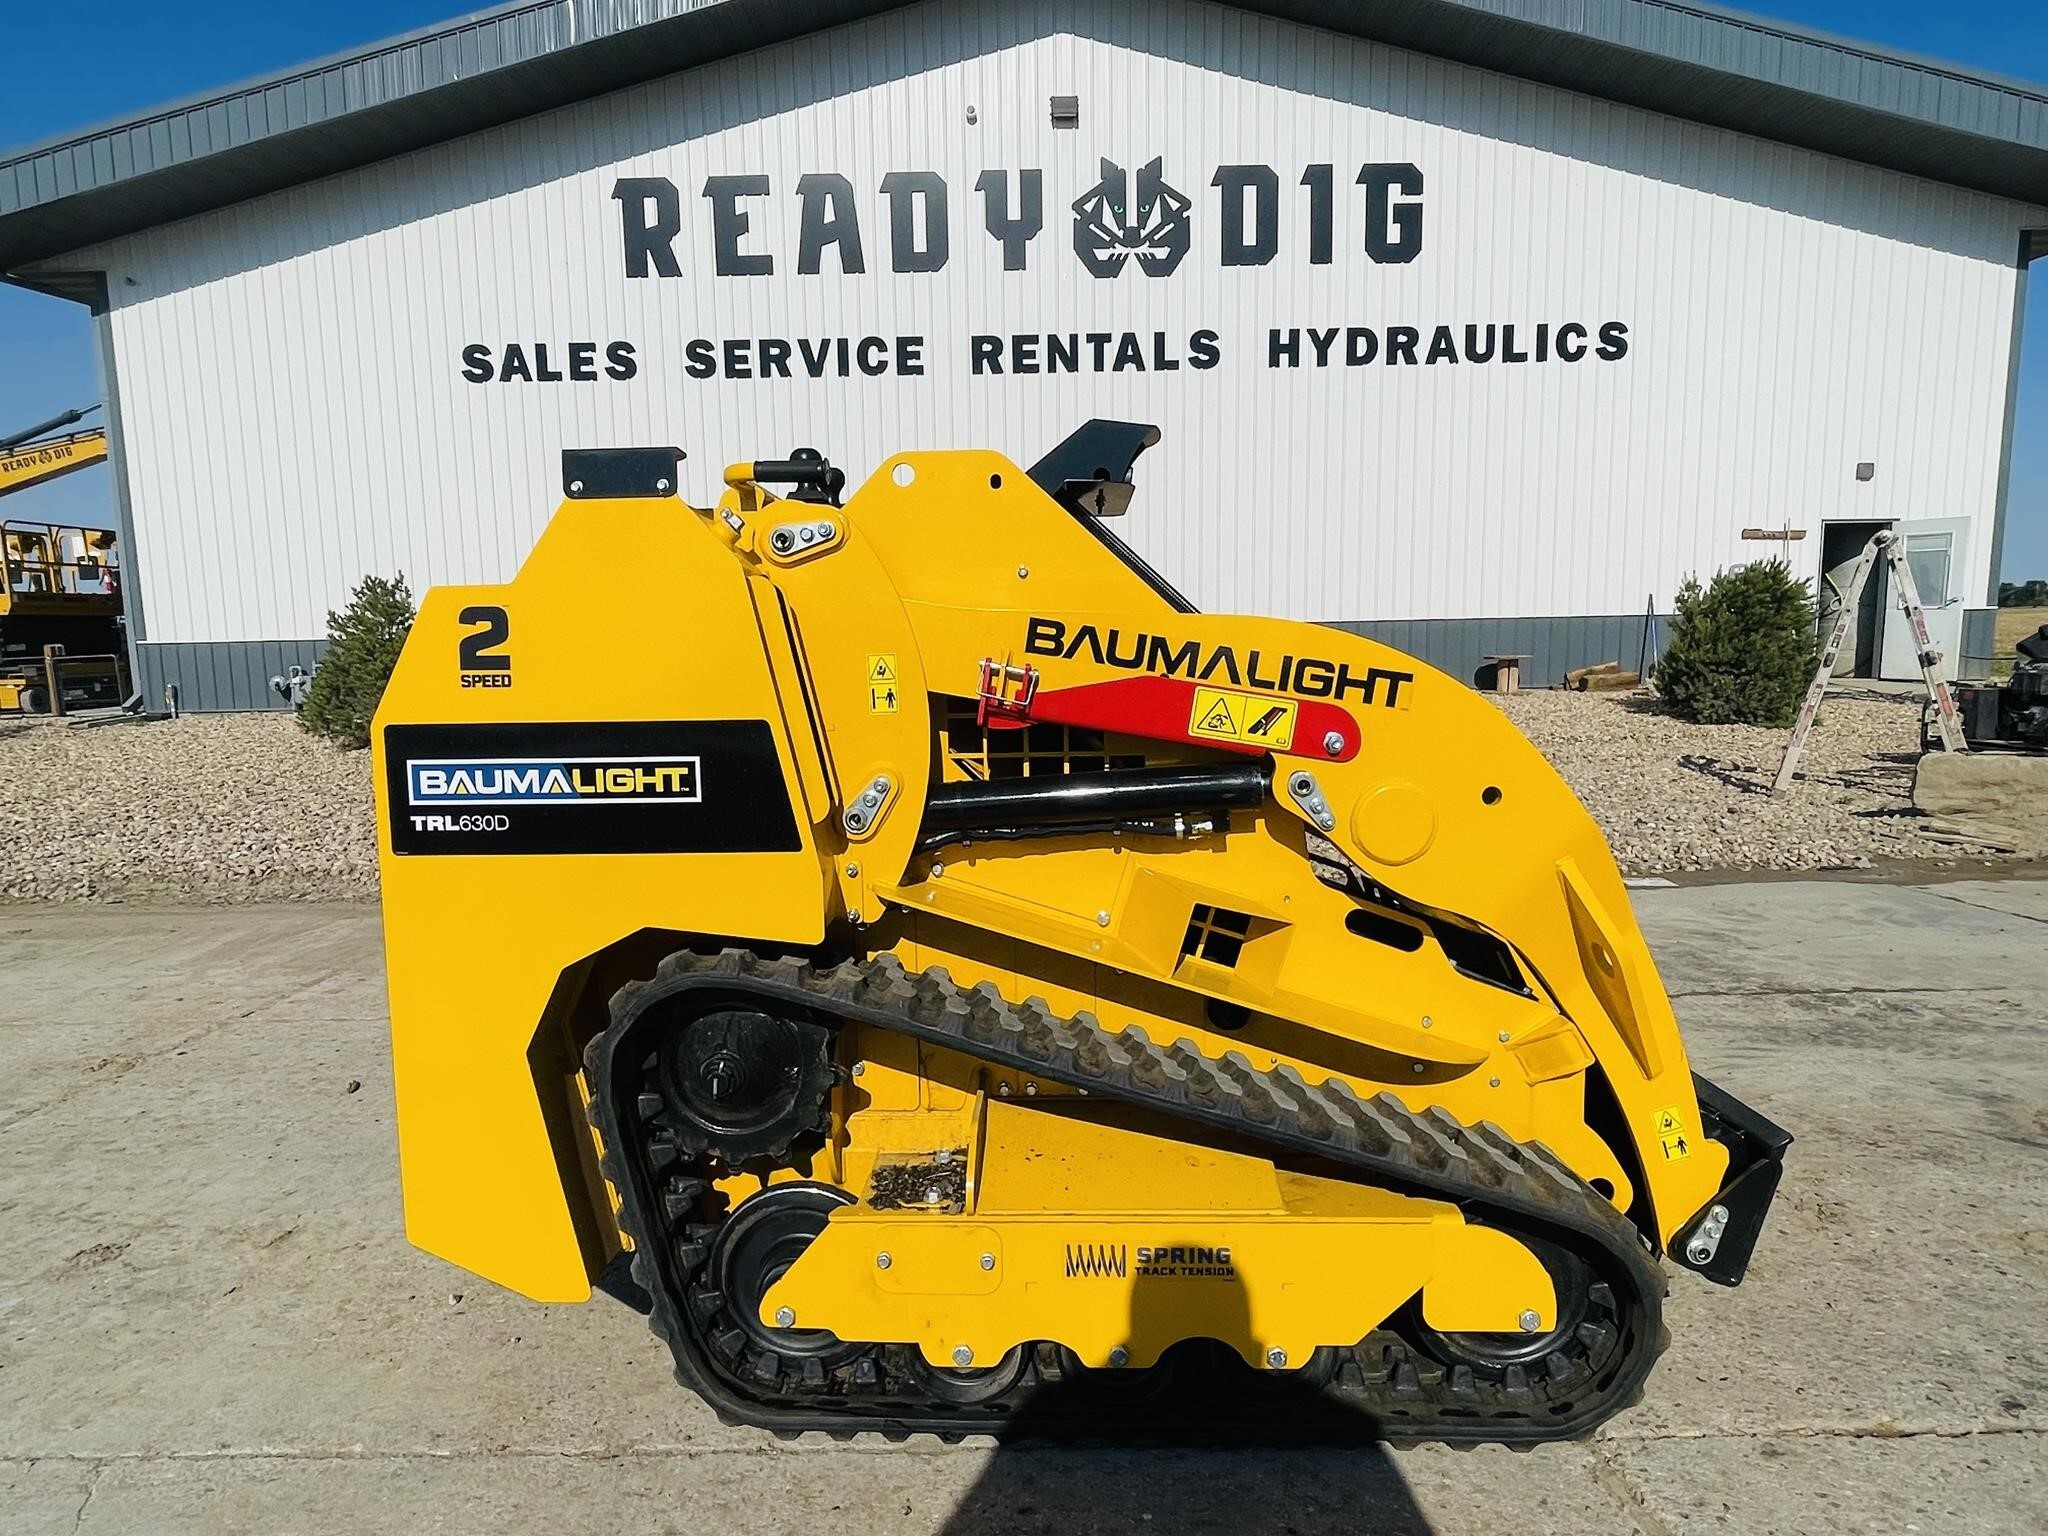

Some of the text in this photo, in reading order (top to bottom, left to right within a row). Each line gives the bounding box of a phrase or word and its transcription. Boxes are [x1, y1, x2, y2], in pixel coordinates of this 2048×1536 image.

[611, 163, 1423, 278] READY DIG
[462, 322, 1628, 383] SALES SERVICE RENTALS HYDRAULICS
[2, 447, 73, 472] READY DIG
[459, 606, 510, 670] 2
[1025, 617, 1413, 708] BAUMALIGHT
[461, 674, 512, 688] SPEED
[410, 815, 509, 831] TRL630D
[1137, 1247, 1231, 1264] SPRING
[1135, 1266, 1234, 1276] TRACK TENSION
